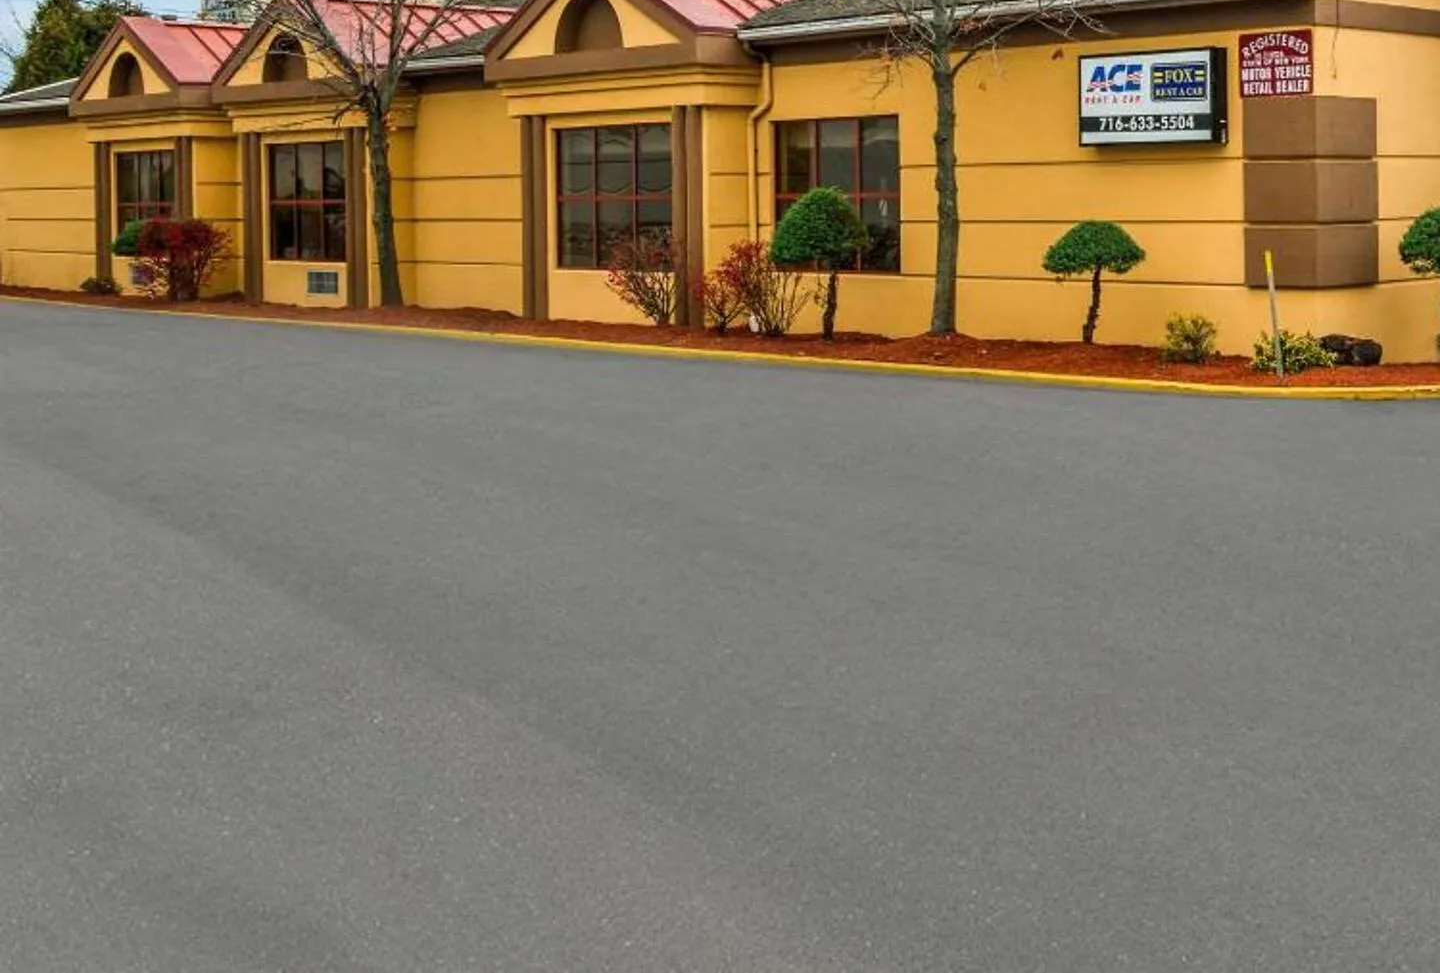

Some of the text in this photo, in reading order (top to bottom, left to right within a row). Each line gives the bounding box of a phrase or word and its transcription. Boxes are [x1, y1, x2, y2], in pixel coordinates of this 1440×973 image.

[1242, 33, 1309, 60] REGISTERED
[1086, 63, 1144, 93] ACE
[1165, 68, 1193, 83] FOX
[1242, 64, 1311, 82] MOTOR VEHICLE
[1155, 88, 1178, 97] RENT
[1186, 86, 1203, 96] CAR
[1243, 78, 1310, 97] RETAIL DEALER
[1099, 115, 1195, 131] 716-633-5504
